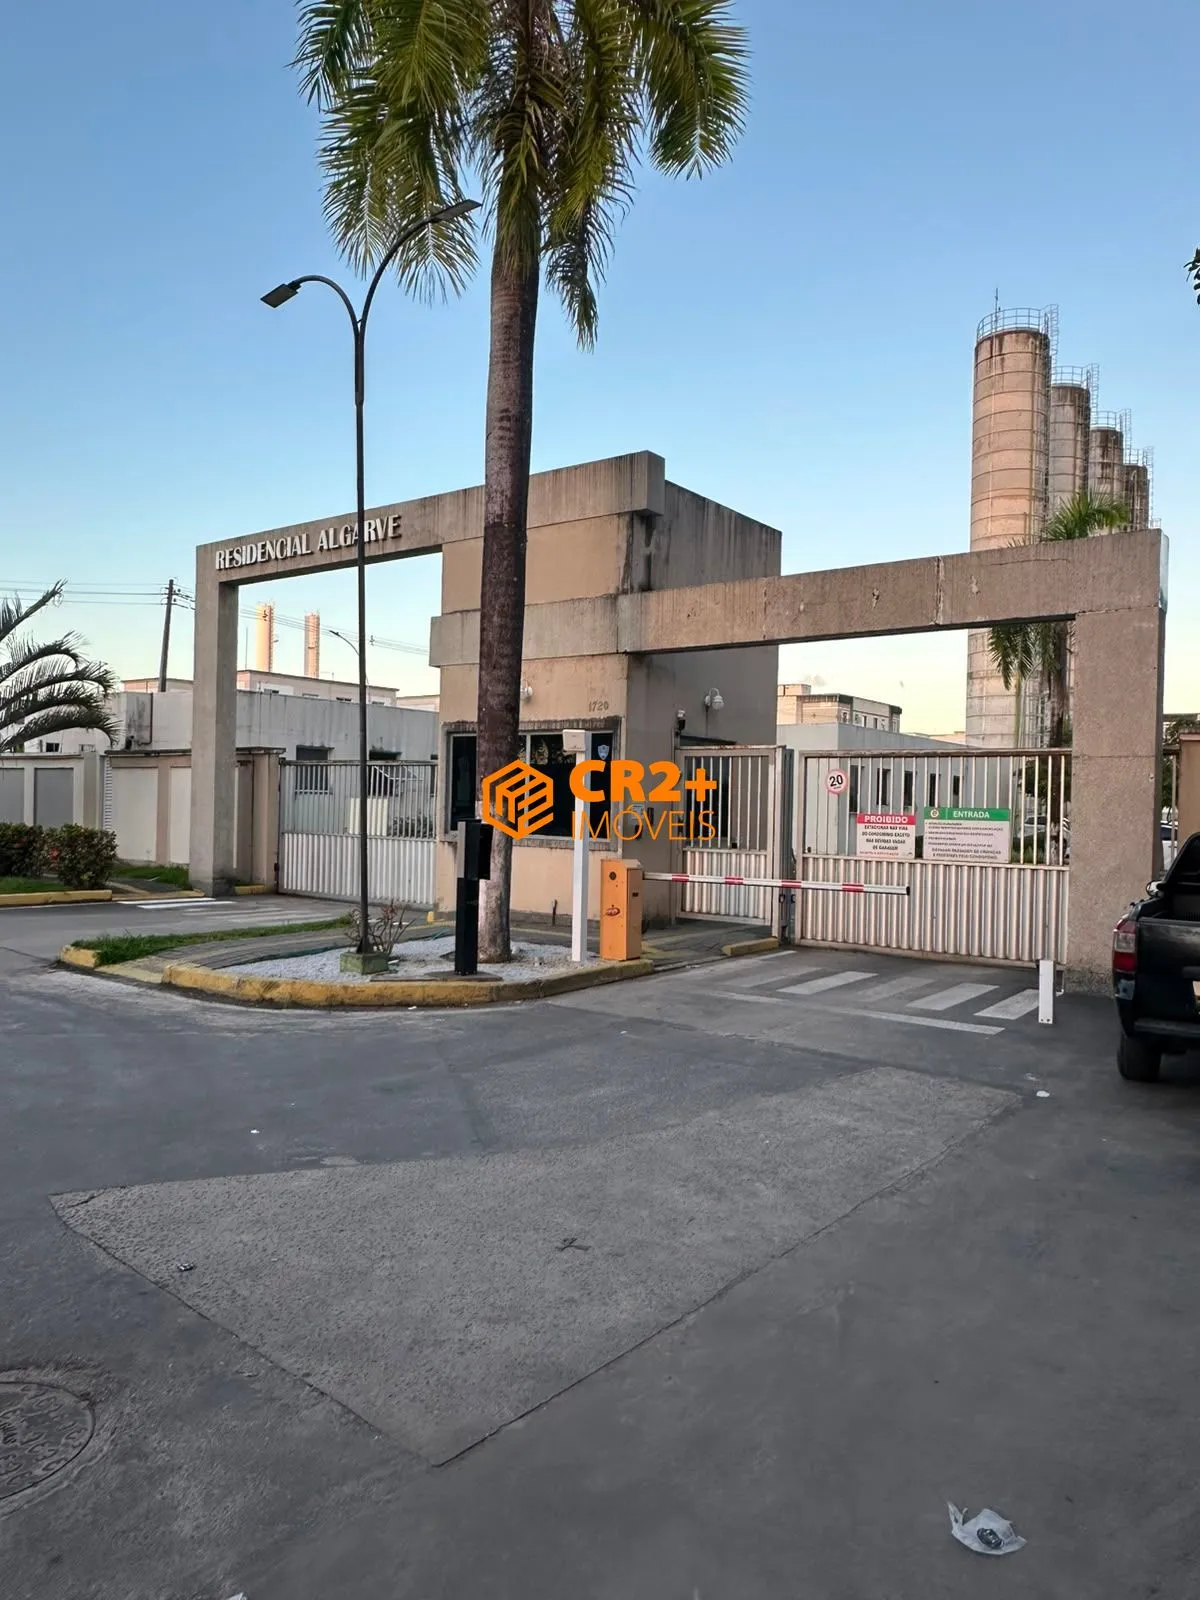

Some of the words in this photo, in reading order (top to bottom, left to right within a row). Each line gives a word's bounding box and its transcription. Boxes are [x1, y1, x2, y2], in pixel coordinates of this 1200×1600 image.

[215, 533, 312, 571] RESIDENCIAL
[588, 700, 609, 712] 1720
[829, 774, 844, 787] 20
[864, 815, 909, 824] PROIBIDO
[953, 810, 990, 819] ENTRADA
